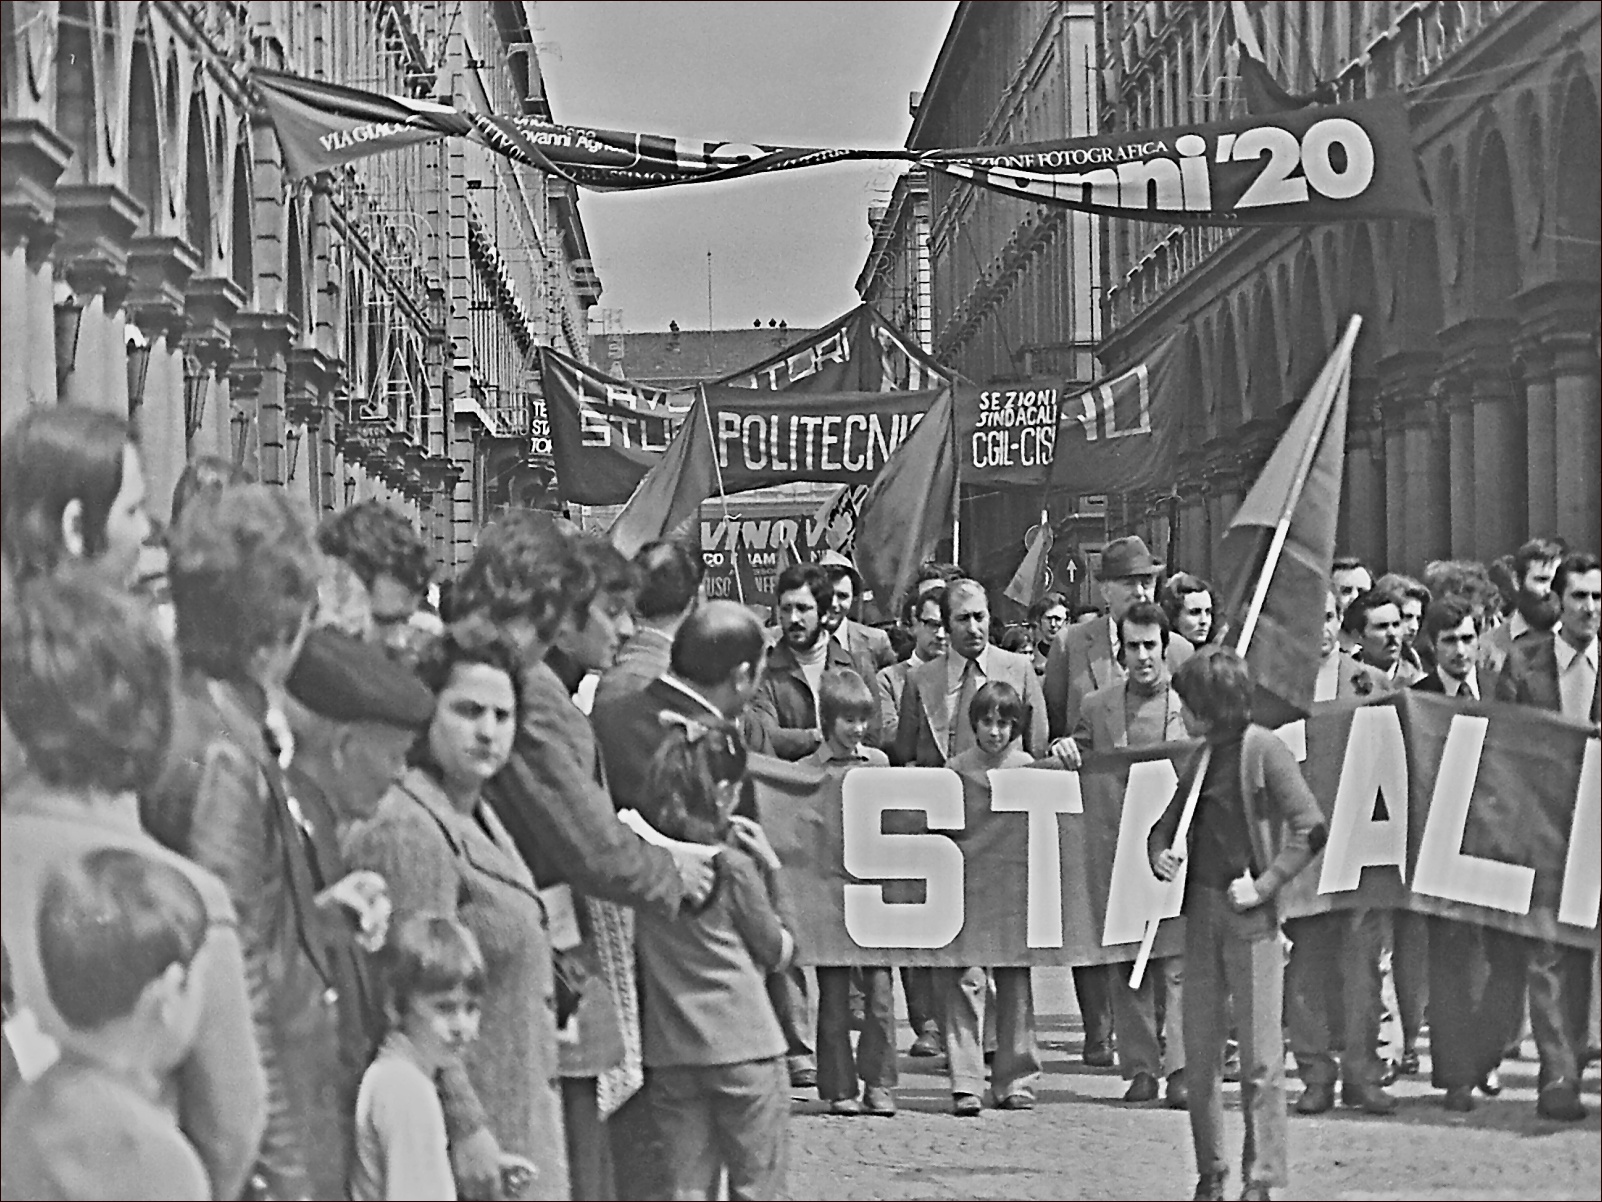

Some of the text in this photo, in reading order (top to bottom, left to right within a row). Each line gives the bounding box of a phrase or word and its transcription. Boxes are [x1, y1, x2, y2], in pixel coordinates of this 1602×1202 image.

[318, 129, 354, 151] VIA
[1037, 140, 1169, 167] FOTOGRAFICA
[1215, 118, 1375, 209] '20
[580, 409, 684, 452] STU
[974, 404, 1058, 427] SINDACALI
[717, 410, 925, 473] POLITECNI
